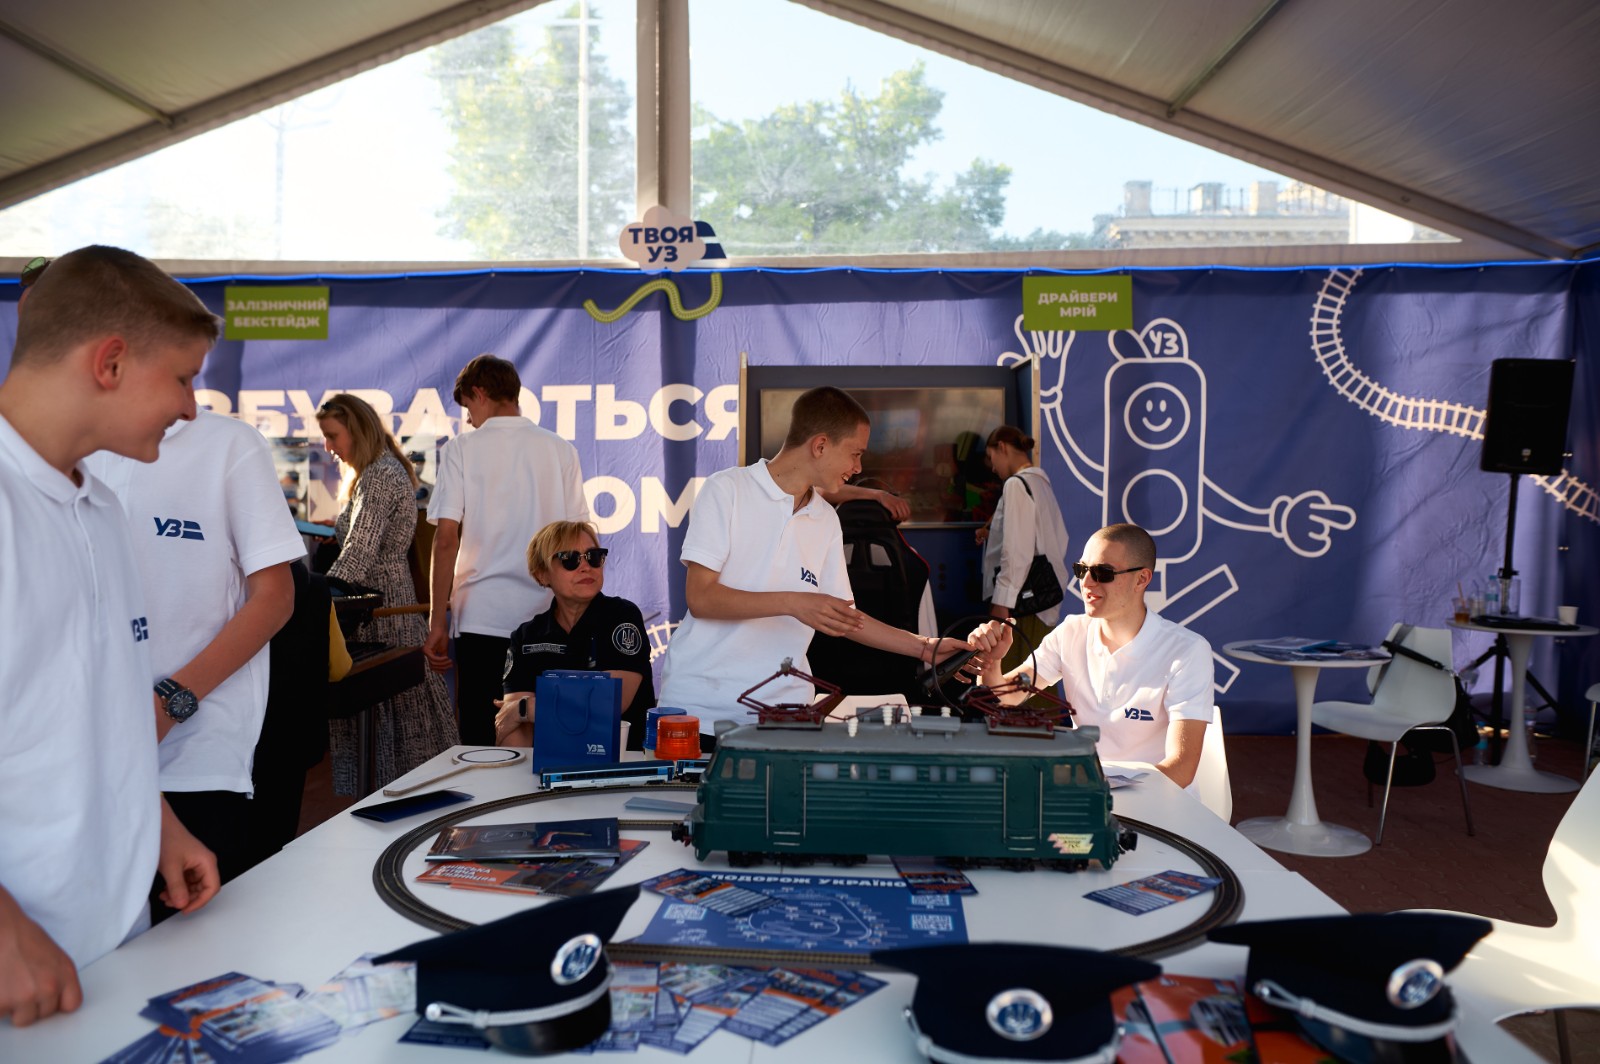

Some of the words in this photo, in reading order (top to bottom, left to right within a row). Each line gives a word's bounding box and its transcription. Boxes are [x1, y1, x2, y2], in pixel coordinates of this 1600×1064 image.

[628, 226, 694, 244] ТВОЯ
[647, 245, 678, 262] УЗ
[1038, 290, 1118, 304] ДРАЙВЕРИ
[227, 299, 327, 311] ЗАЛІЗНИЧНИЙ
[1060, 305, 1097, 317] МРІЙ
[233, 315, 320, 328] БЕКСТЕЙДЖ
[818, 877, 908, 888] УКРАЇНО
